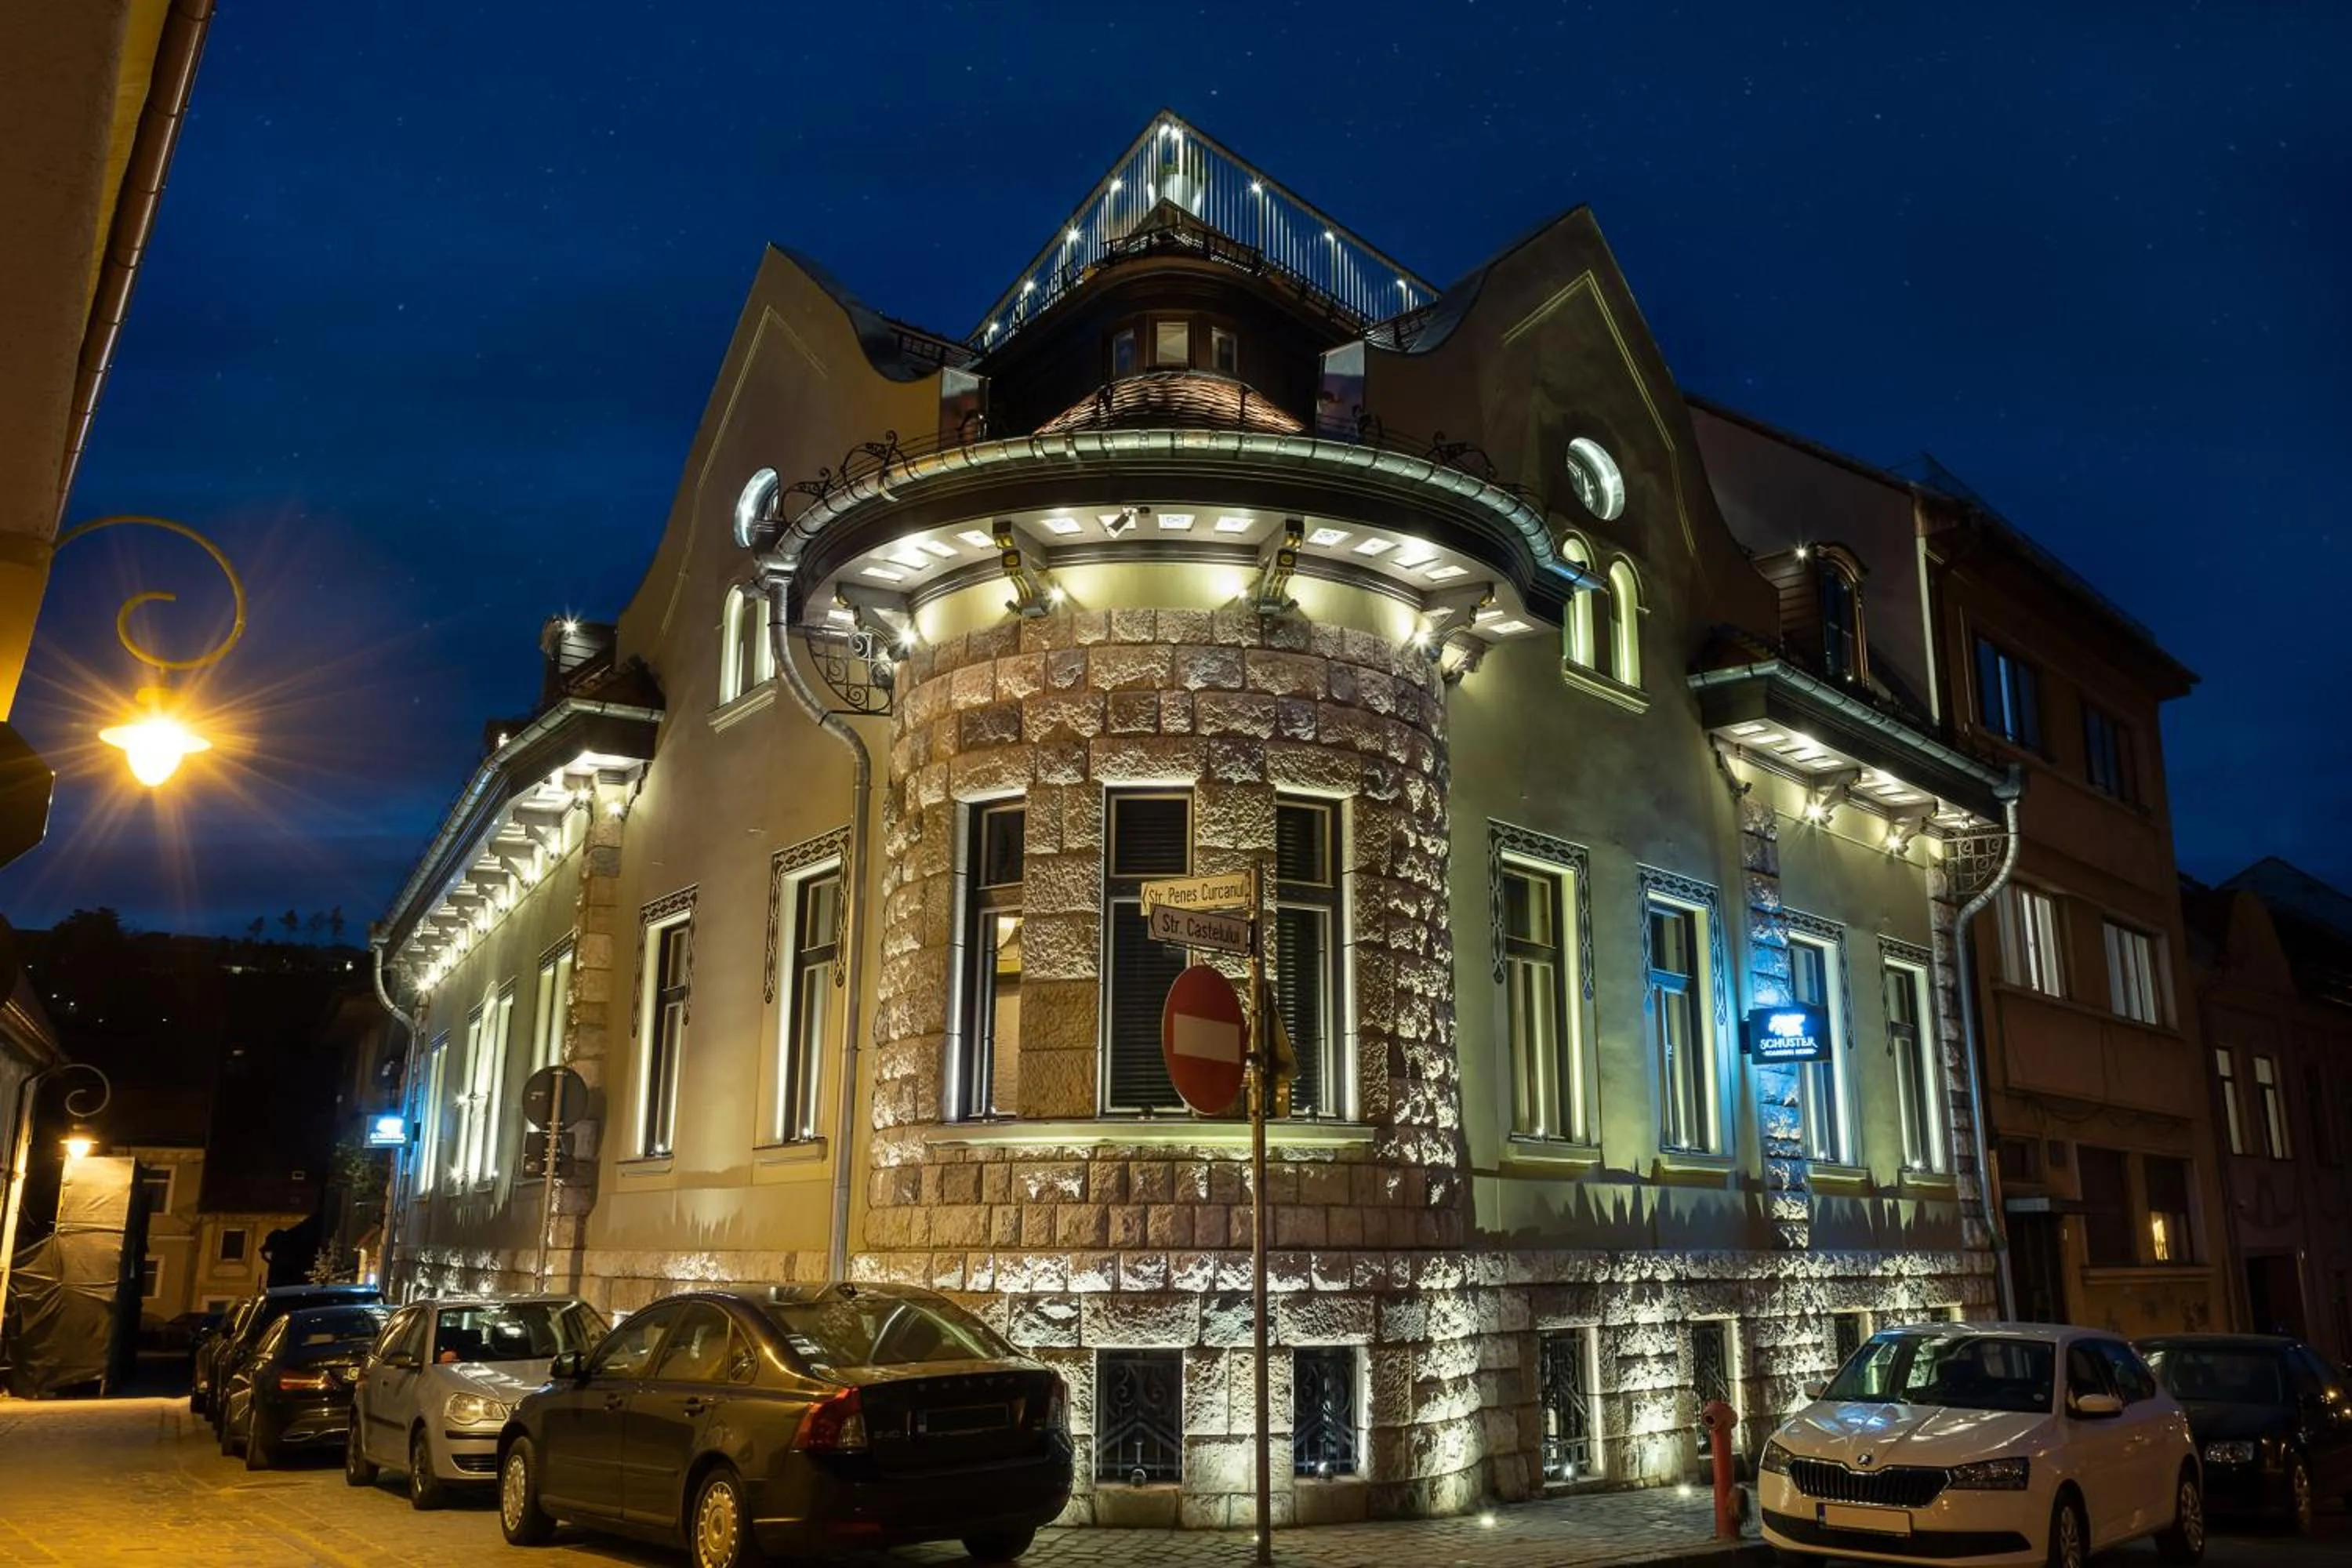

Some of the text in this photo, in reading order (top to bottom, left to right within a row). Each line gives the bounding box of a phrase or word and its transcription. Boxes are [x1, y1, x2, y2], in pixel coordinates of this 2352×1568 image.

[1149, 888, 1166, 905] Str.
[1162, 914, 1182, 934] Str.
[1759, 1036, 1818, 1050] SCHUSTER
